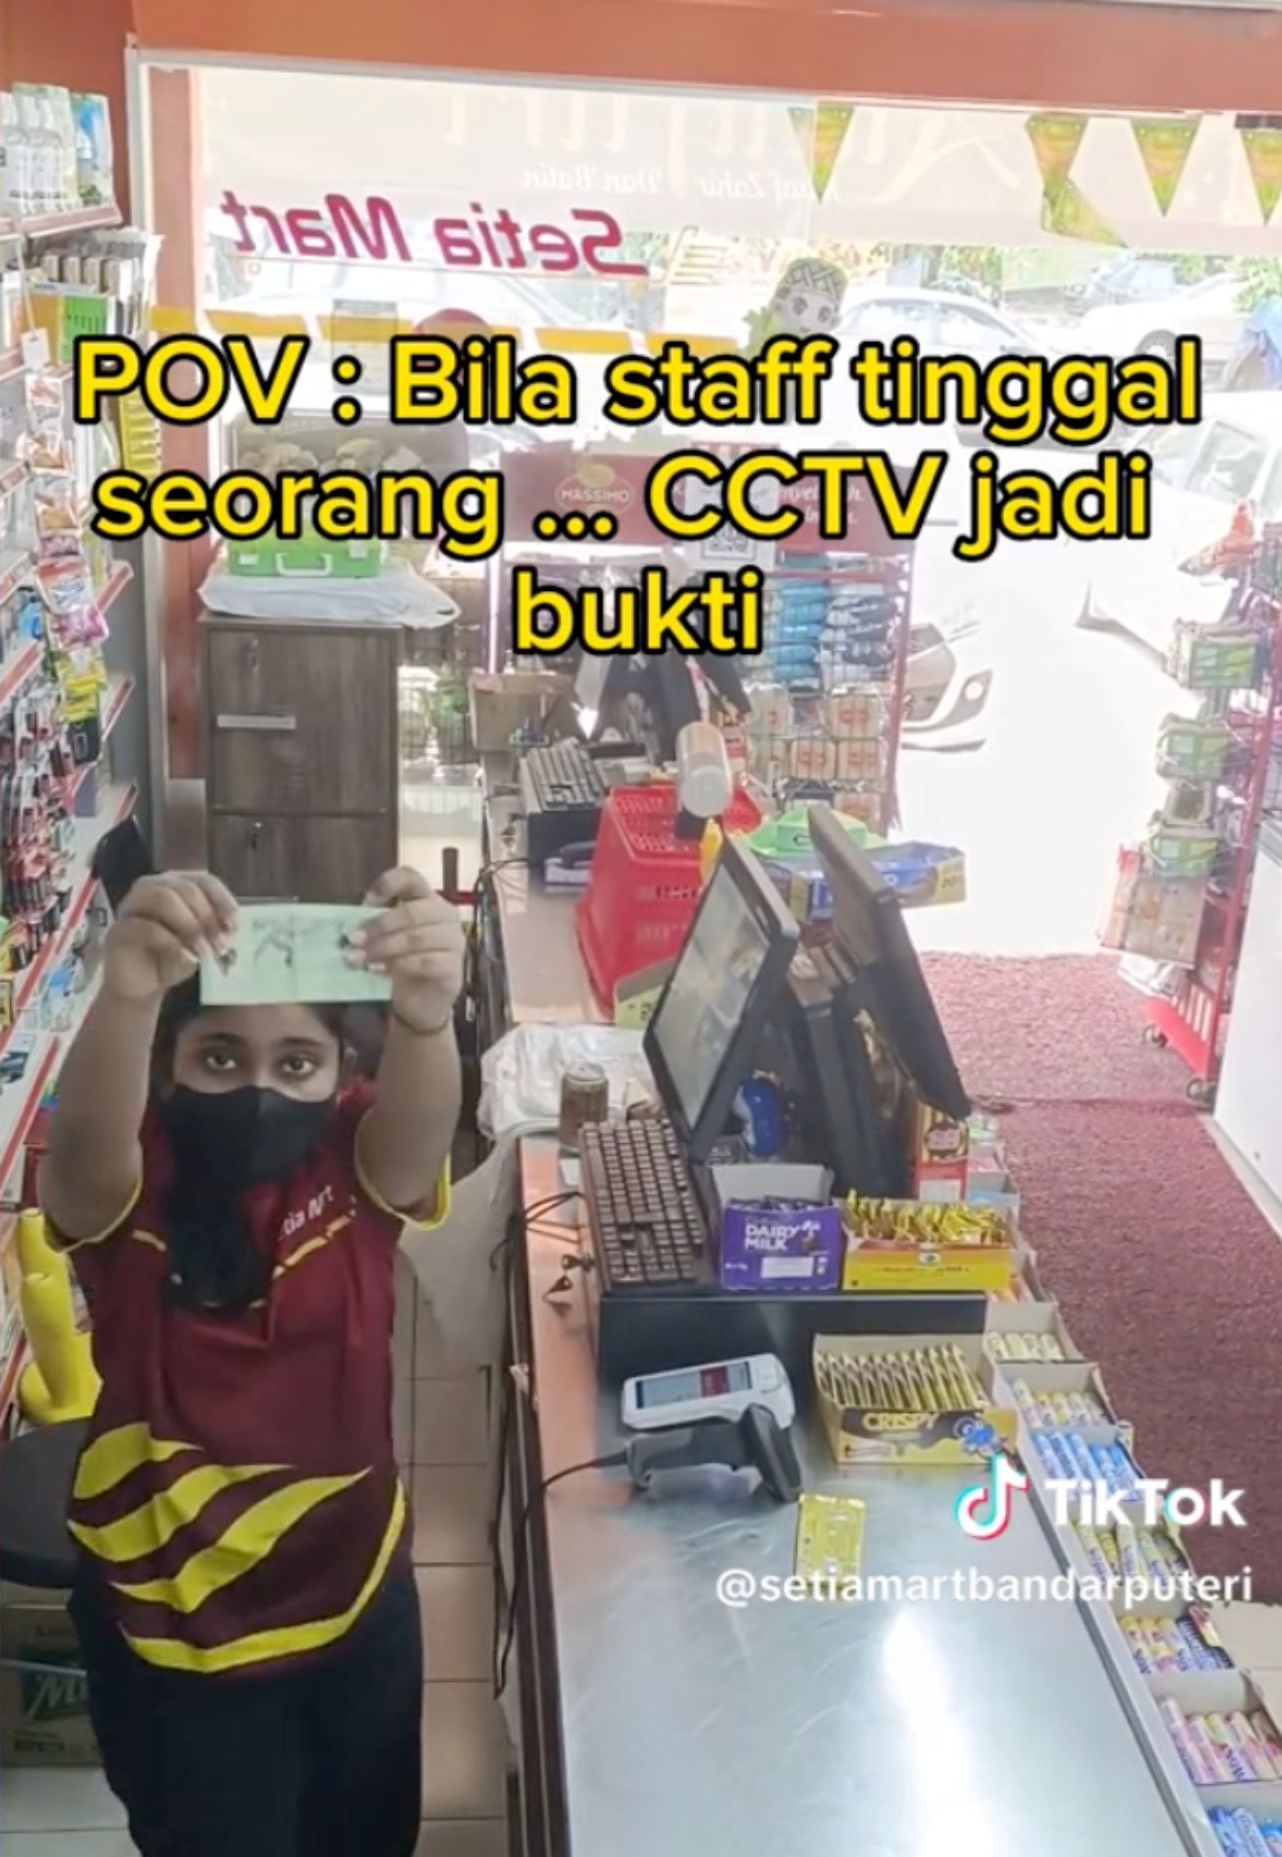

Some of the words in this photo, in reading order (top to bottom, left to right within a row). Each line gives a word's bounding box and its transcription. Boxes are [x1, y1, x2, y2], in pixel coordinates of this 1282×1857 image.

[560, 488, 630, 504] MASSIMO
[744, 1222, 799, 1239] DAIRY
[744, 1237, 788, 1251] MILK
[862, 1411, 940, 1432] CRISPY
